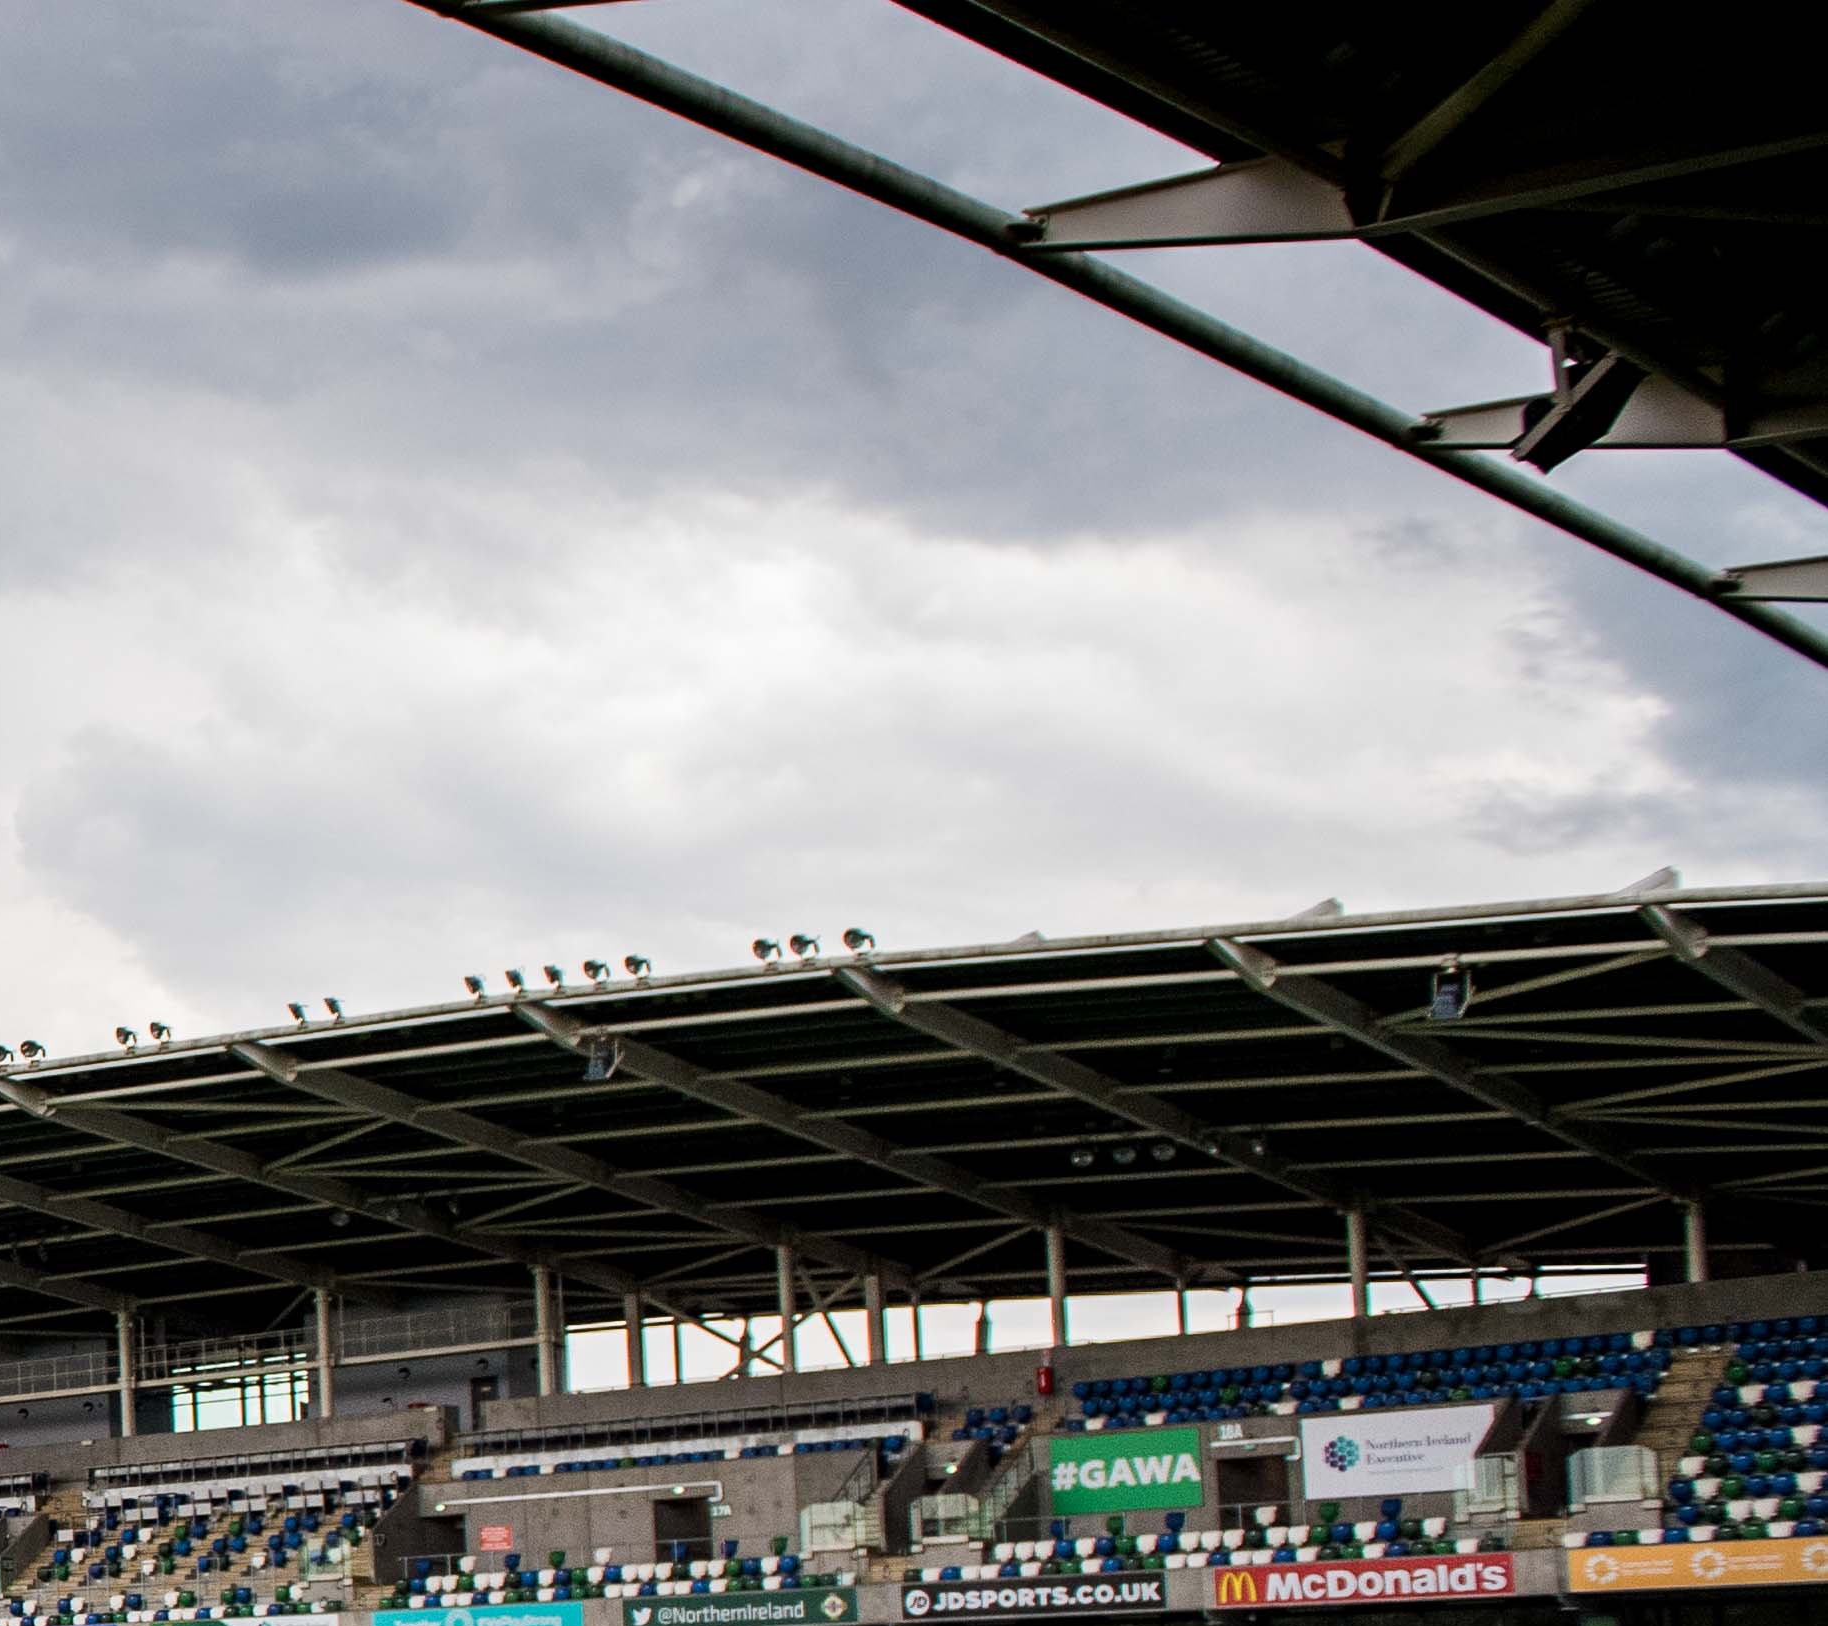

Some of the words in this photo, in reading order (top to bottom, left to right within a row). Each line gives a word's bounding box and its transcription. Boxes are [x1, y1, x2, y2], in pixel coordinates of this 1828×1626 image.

[1365, 1437, 1422, 1449] Northern
[1424, 1433, 1472, 1446] Ireland
[1052, 1453, 1201, 1491] #GAWA
[1366, 1453, 1425, 1465] Executive
[1265, 1562, 1508, 1602] McDonald's
[932, 1582, 1162, 1612] JDSPORTS.CO.UK
[658, 1600, 805, 1625] @NorthernIreland
